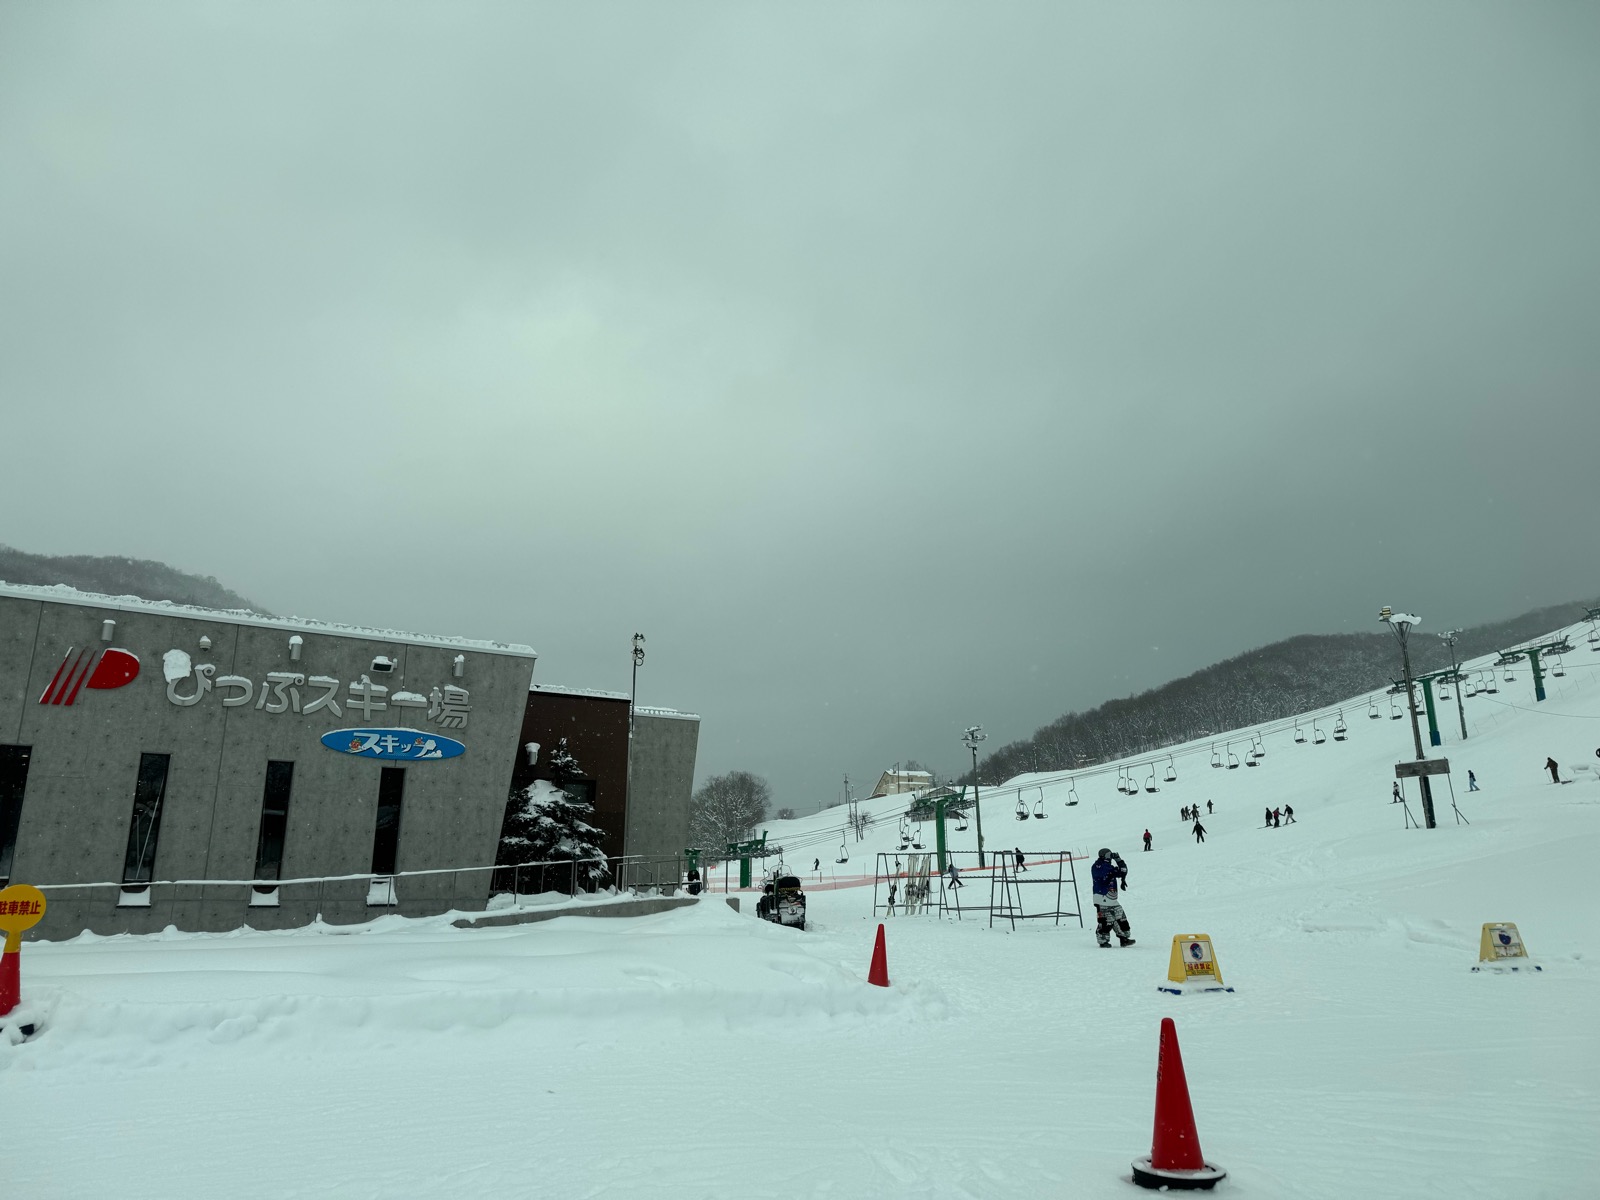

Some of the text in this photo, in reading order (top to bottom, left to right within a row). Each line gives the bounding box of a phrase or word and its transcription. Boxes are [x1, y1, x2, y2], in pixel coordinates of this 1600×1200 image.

[165, 663, 472, 729] ぴっぷスキー場
[0, 900, 41, 916] 駐車禁止
